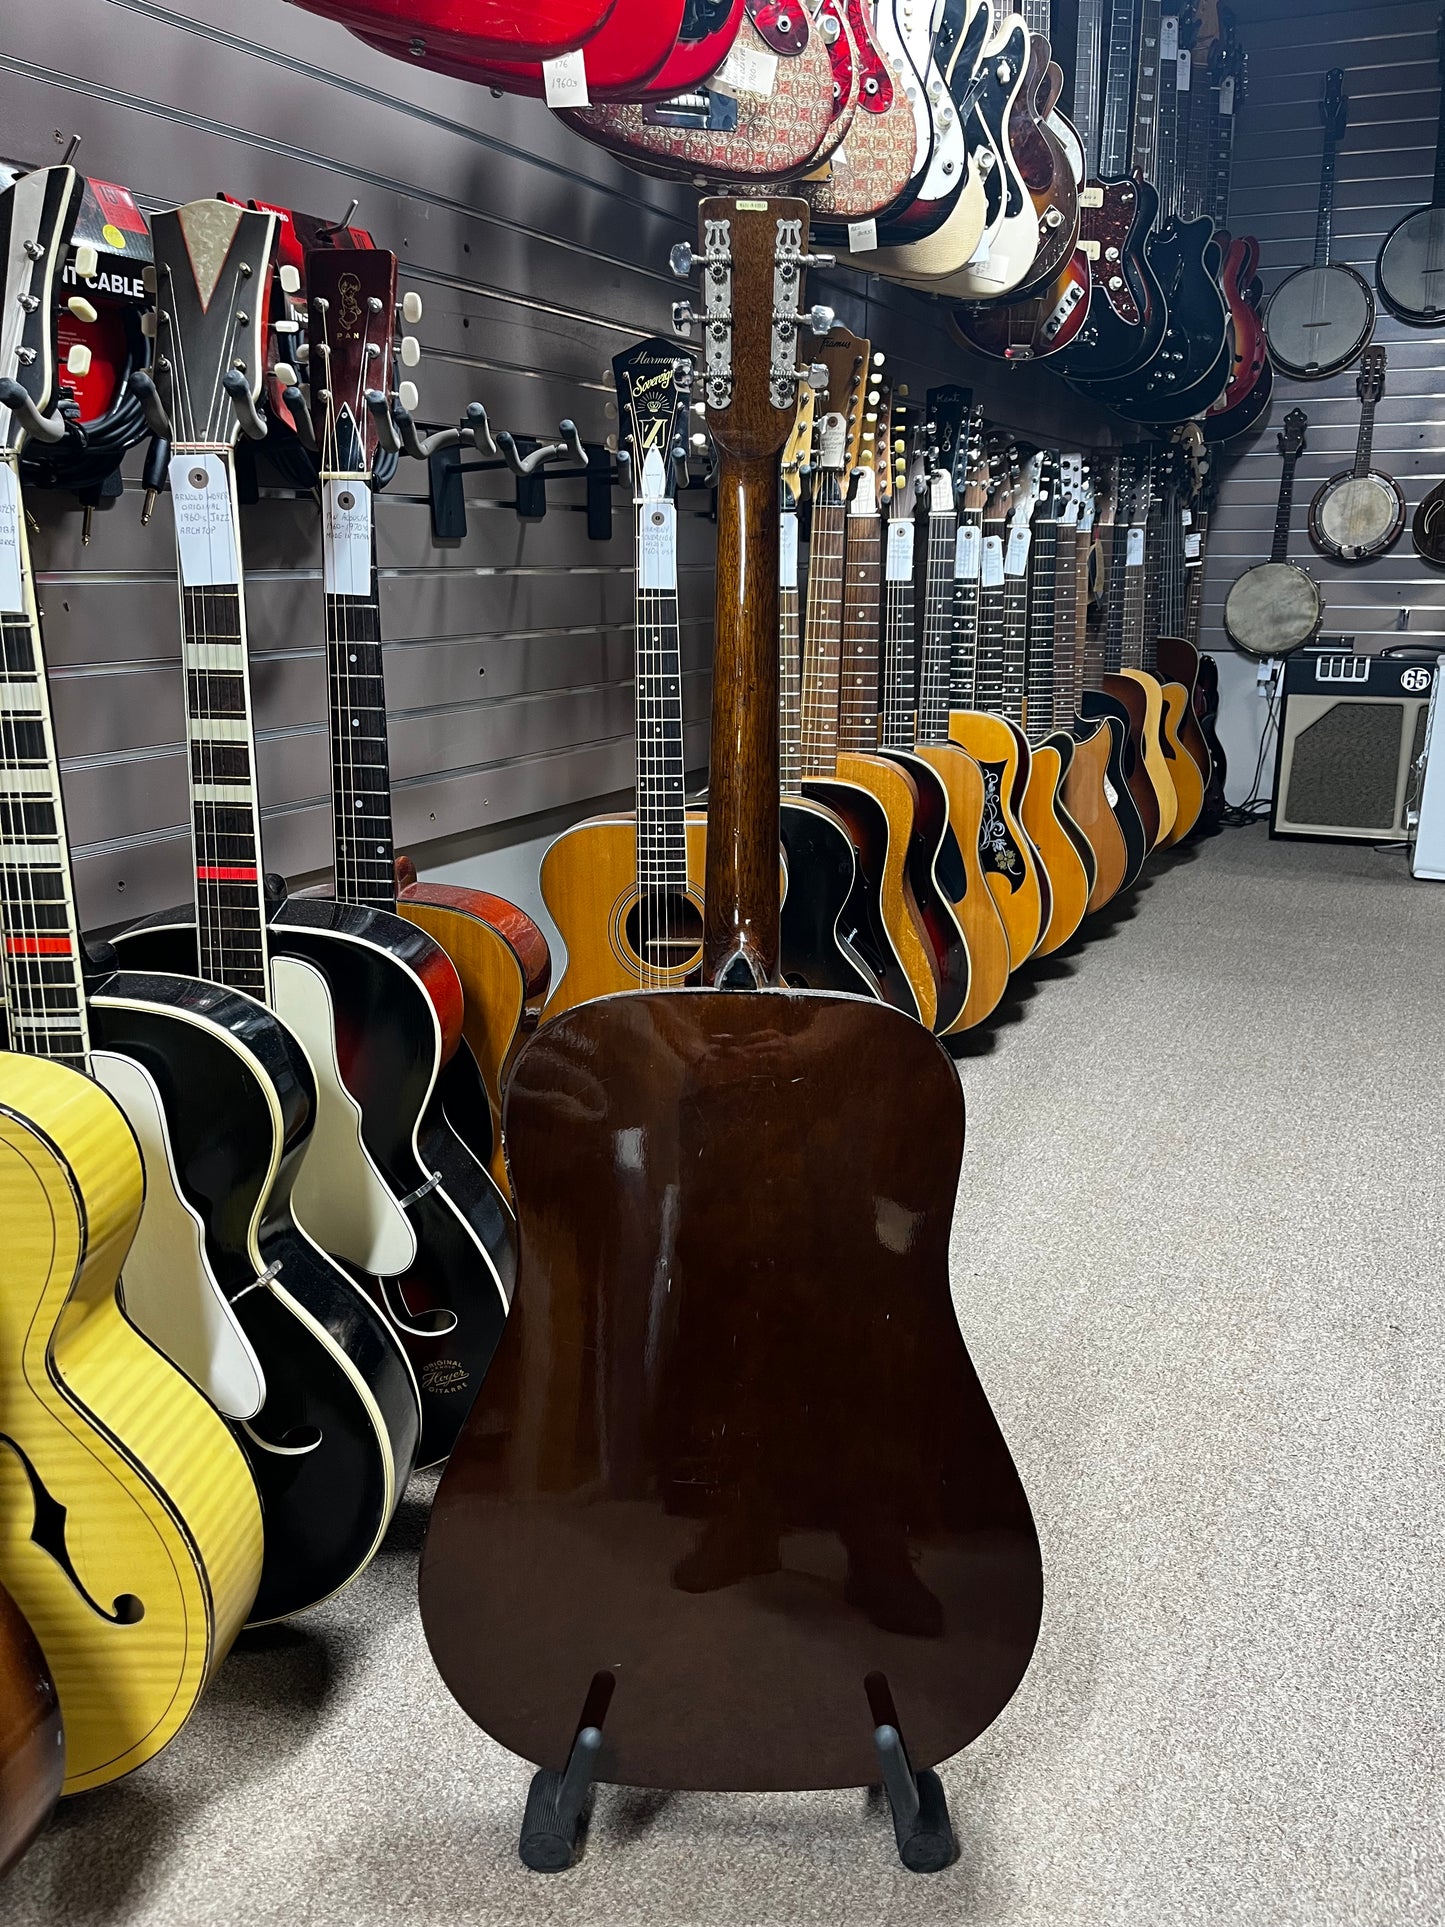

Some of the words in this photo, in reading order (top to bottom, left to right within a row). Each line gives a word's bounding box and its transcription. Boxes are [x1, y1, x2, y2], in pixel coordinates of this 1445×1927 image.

[85, 272, 145, 298] CABLE
[336, 332, 360, 340] PAN
[819, 337, 852, 354] Framus
[1404, 670, 1428, 690] 65
